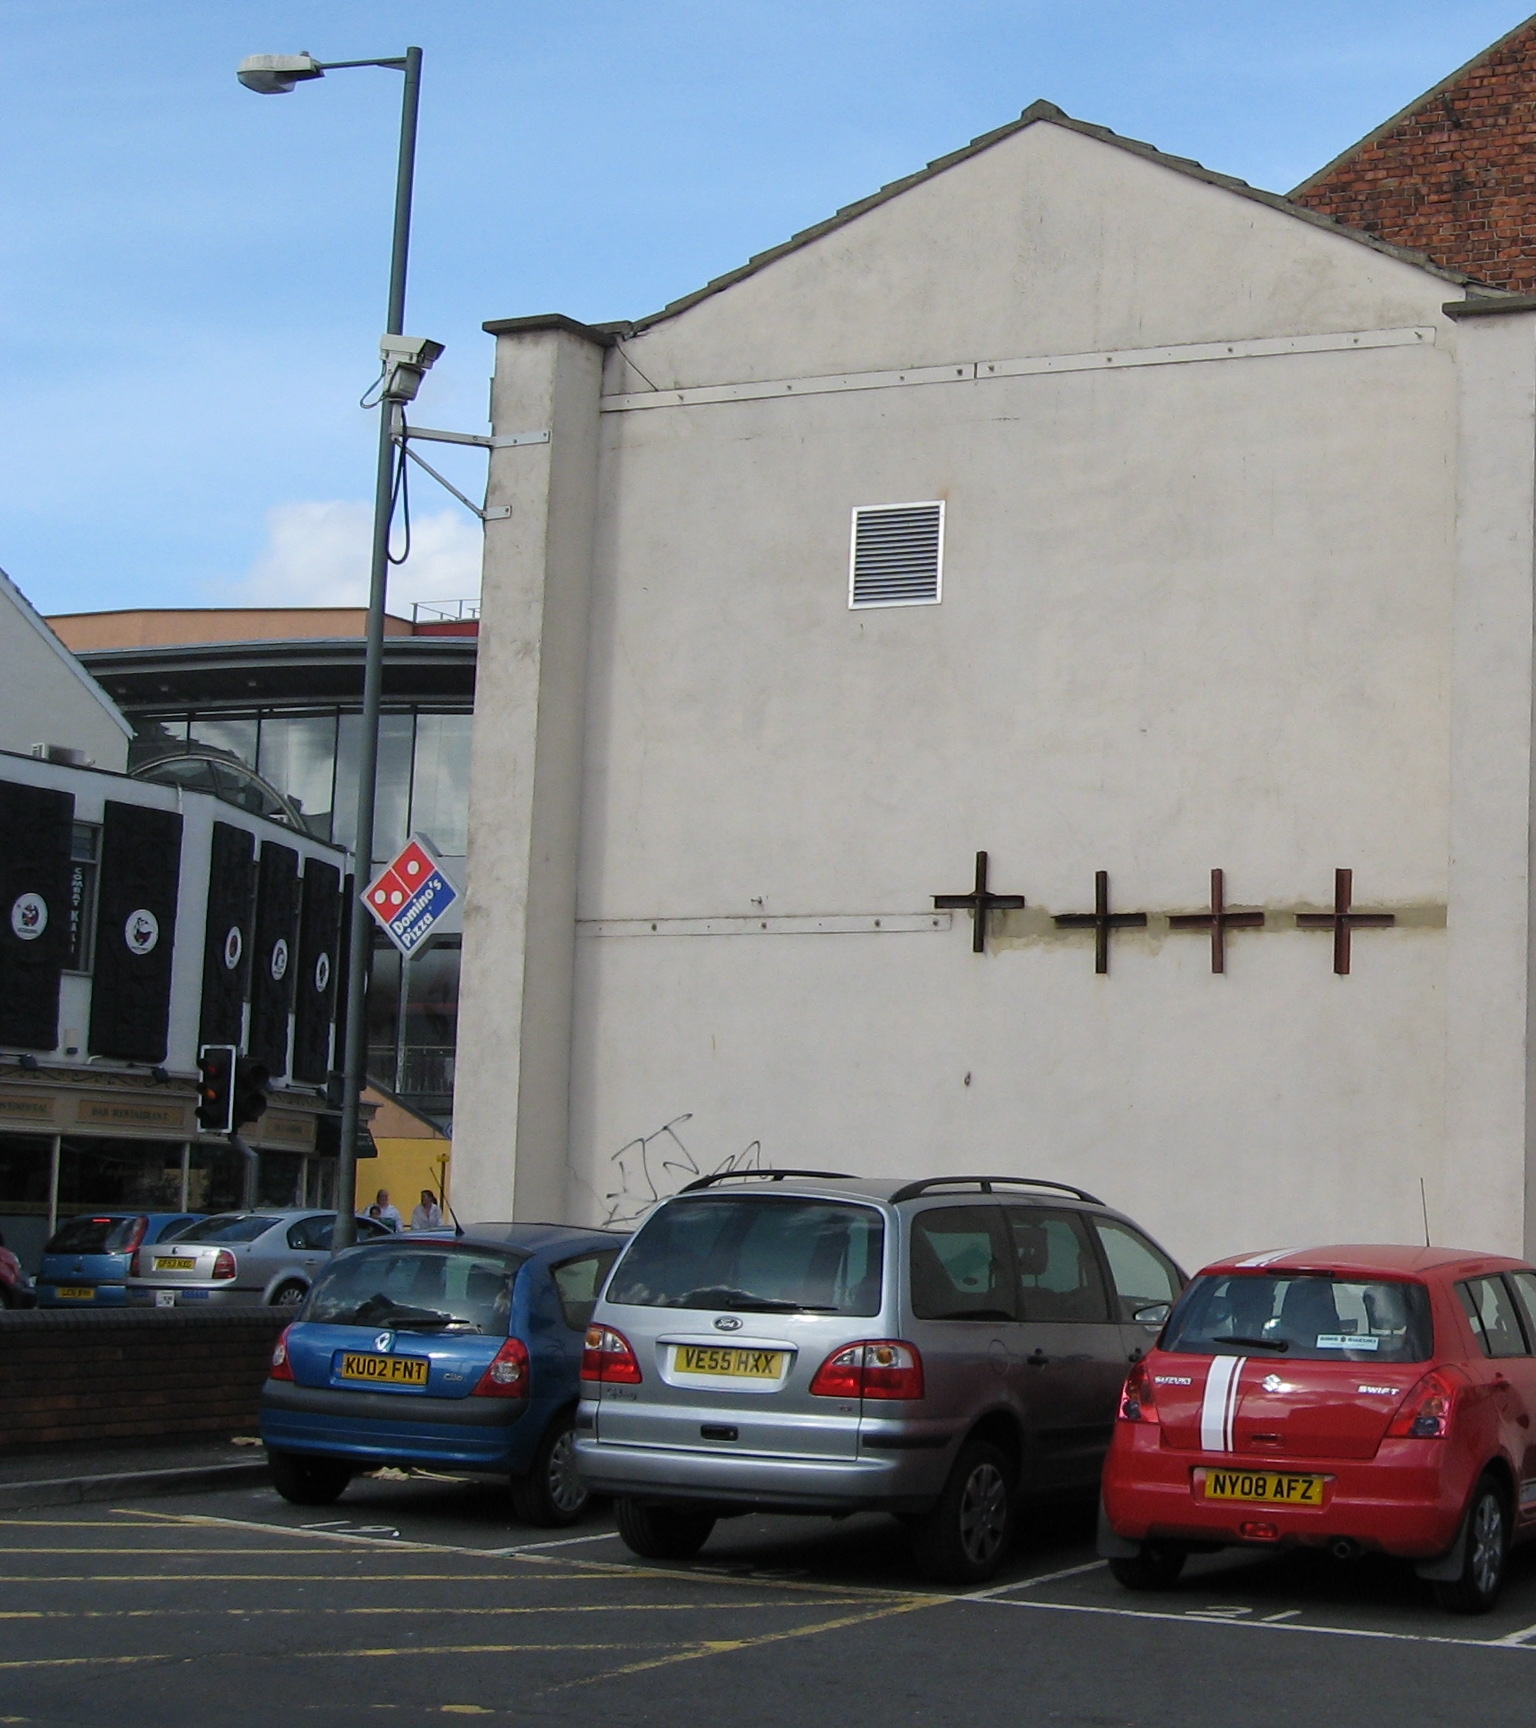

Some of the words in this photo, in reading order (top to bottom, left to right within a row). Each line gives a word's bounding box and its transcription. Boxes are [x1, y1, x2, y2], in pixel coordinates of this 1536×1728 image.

[391, 879, 442, 935] Domino's
[401, 913, 433, 947] Pizza
[345, 1357, 387, 1376] KU02
[392, 1361, 425, 1380] FNT
[685, 1349, 731, 1371] VE55
[736, 1353, 776, 1374] HXX
[1154, 1375, 1192, 1385] SUZUKI
[1357, 1385, 1400, 1396] SWIFT
[1213, 1474, 1267, 1497] NY08
[1273, 1479, 1314, 1500] AFZ
